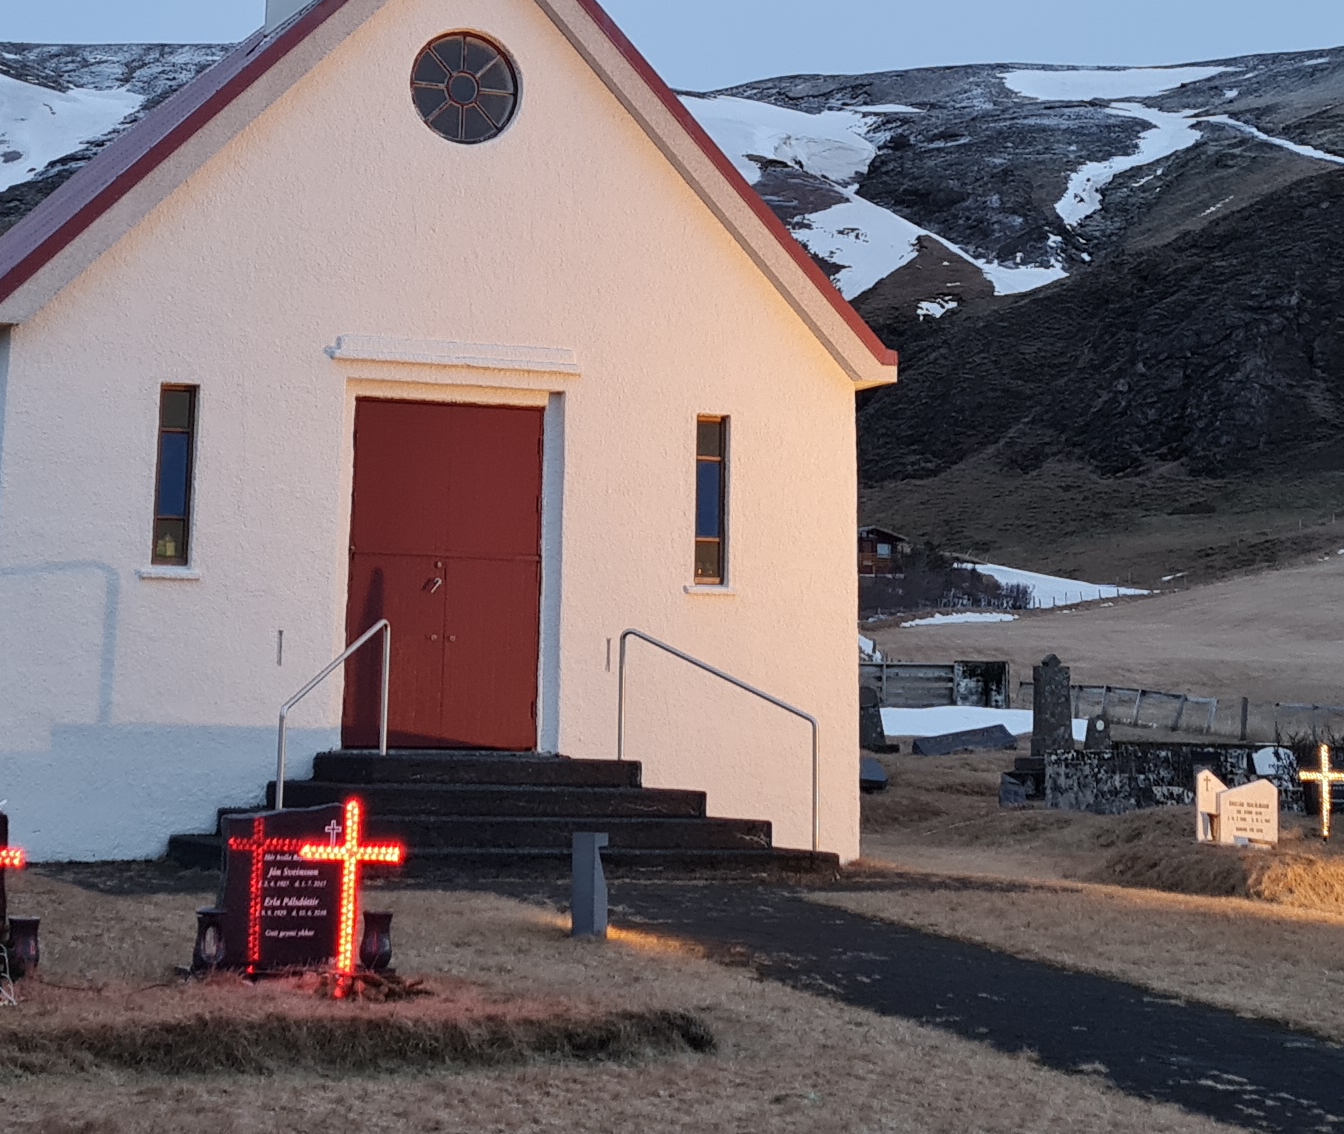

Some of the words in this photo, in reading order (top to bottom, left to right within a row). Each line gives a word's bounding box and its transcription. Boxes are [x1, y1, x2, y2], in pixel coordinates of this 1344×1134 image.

[267, 866, 282, 878] Jón
[282, 866, 319, 877] Sveinsson
[264, 896, 281, 907] Erla
[282, 895, 320, 907] Pálsdóttir
